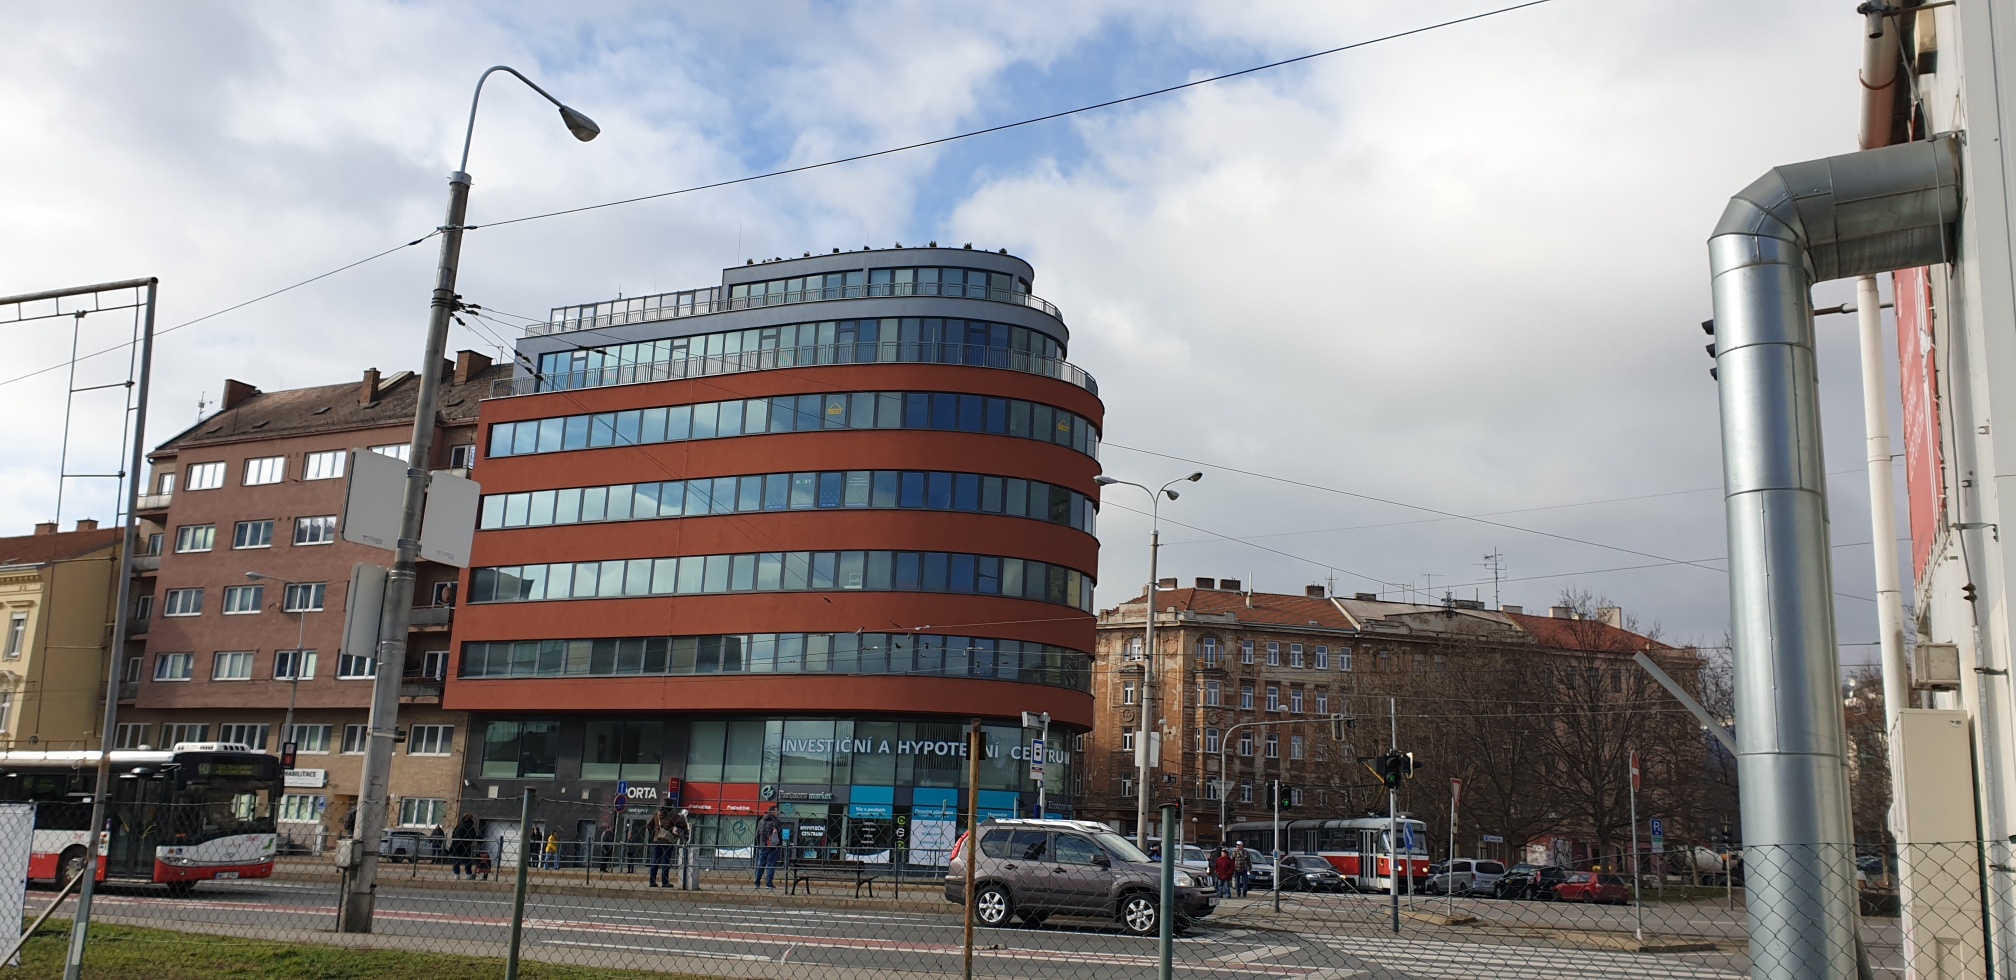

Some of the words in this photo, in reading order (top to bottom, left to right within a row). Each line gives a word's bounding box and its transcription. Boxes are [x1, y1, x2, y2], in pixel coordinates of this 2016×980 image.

[782, 736, 872, 753] INVESTIČNÍ
[878, 740, 890, 753] A
[898, 740, 1000, 758] HYPOTENÍ
[1010, 745, 1070, 765] CERUM
[625, 786, 657, 799] ORTA
[778, 789, 808, 799] Partners
[808, 791, 832, 800] market
